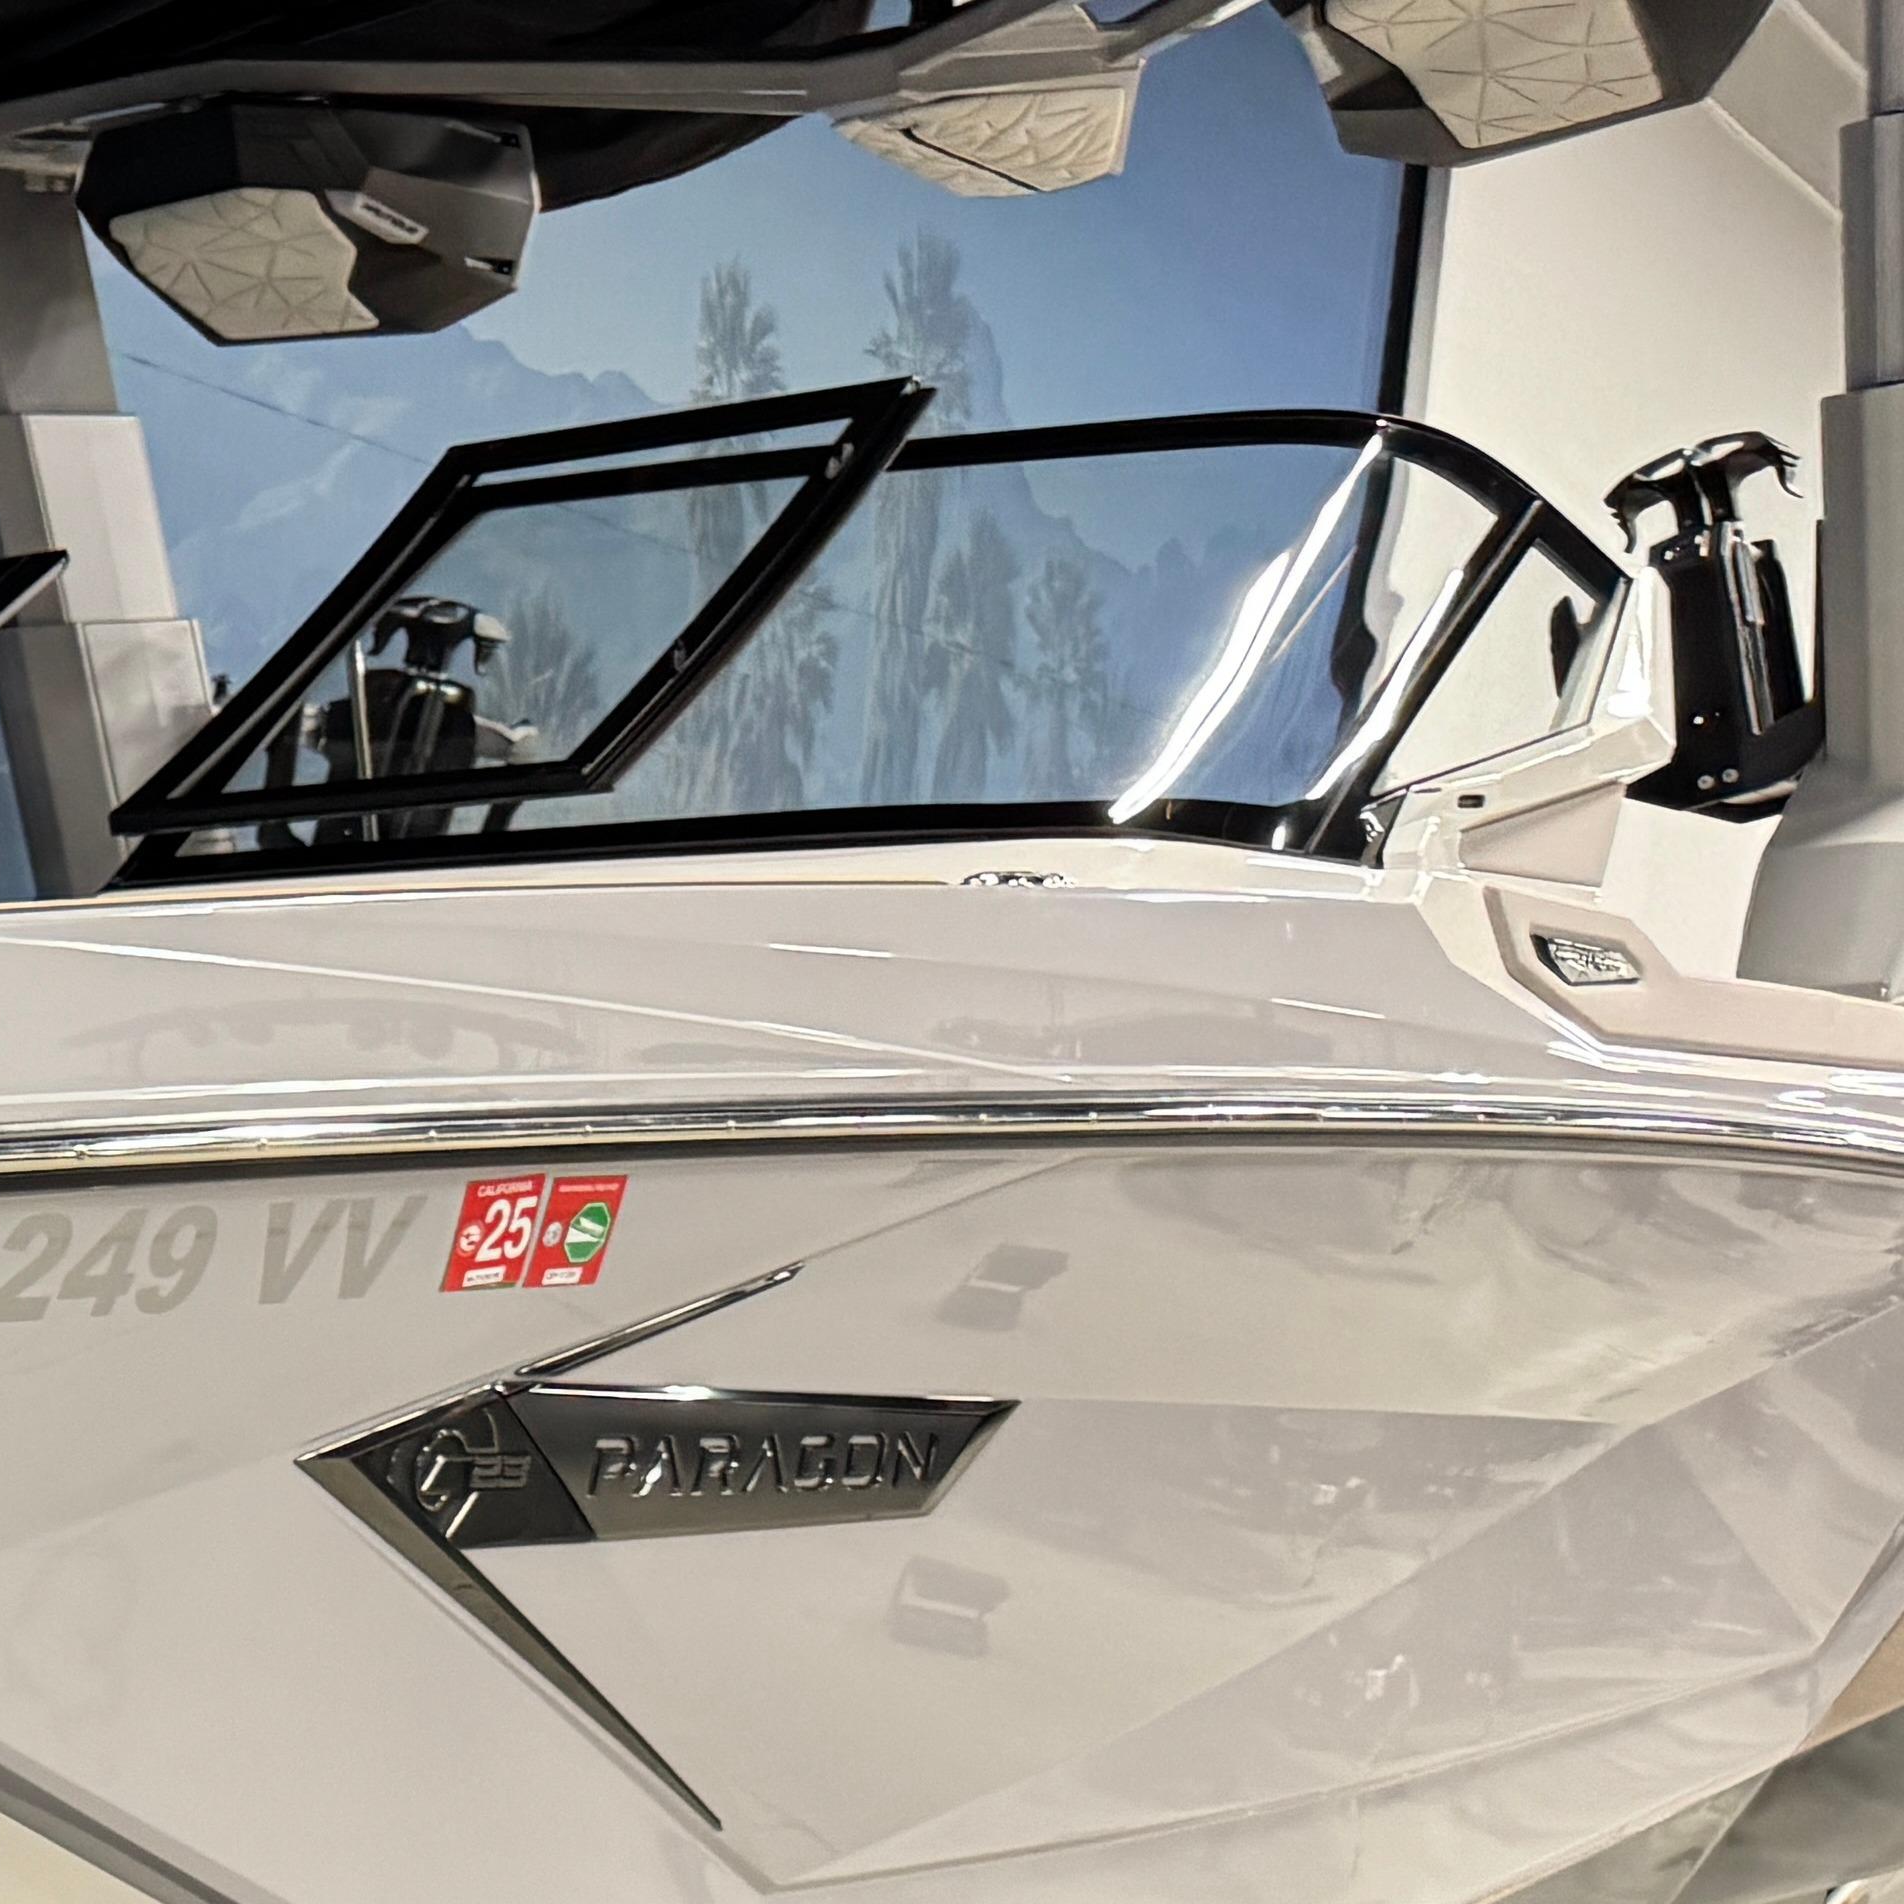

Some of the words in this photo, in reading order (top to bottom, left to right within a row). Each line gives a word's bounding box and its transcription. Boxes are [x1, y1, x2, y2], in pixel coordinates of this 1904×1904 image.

[257, 1195, 428, 1304] VV
[474, 1196, 539, 1263] 25
[585, 1430, 940, 1499] PARAGON
